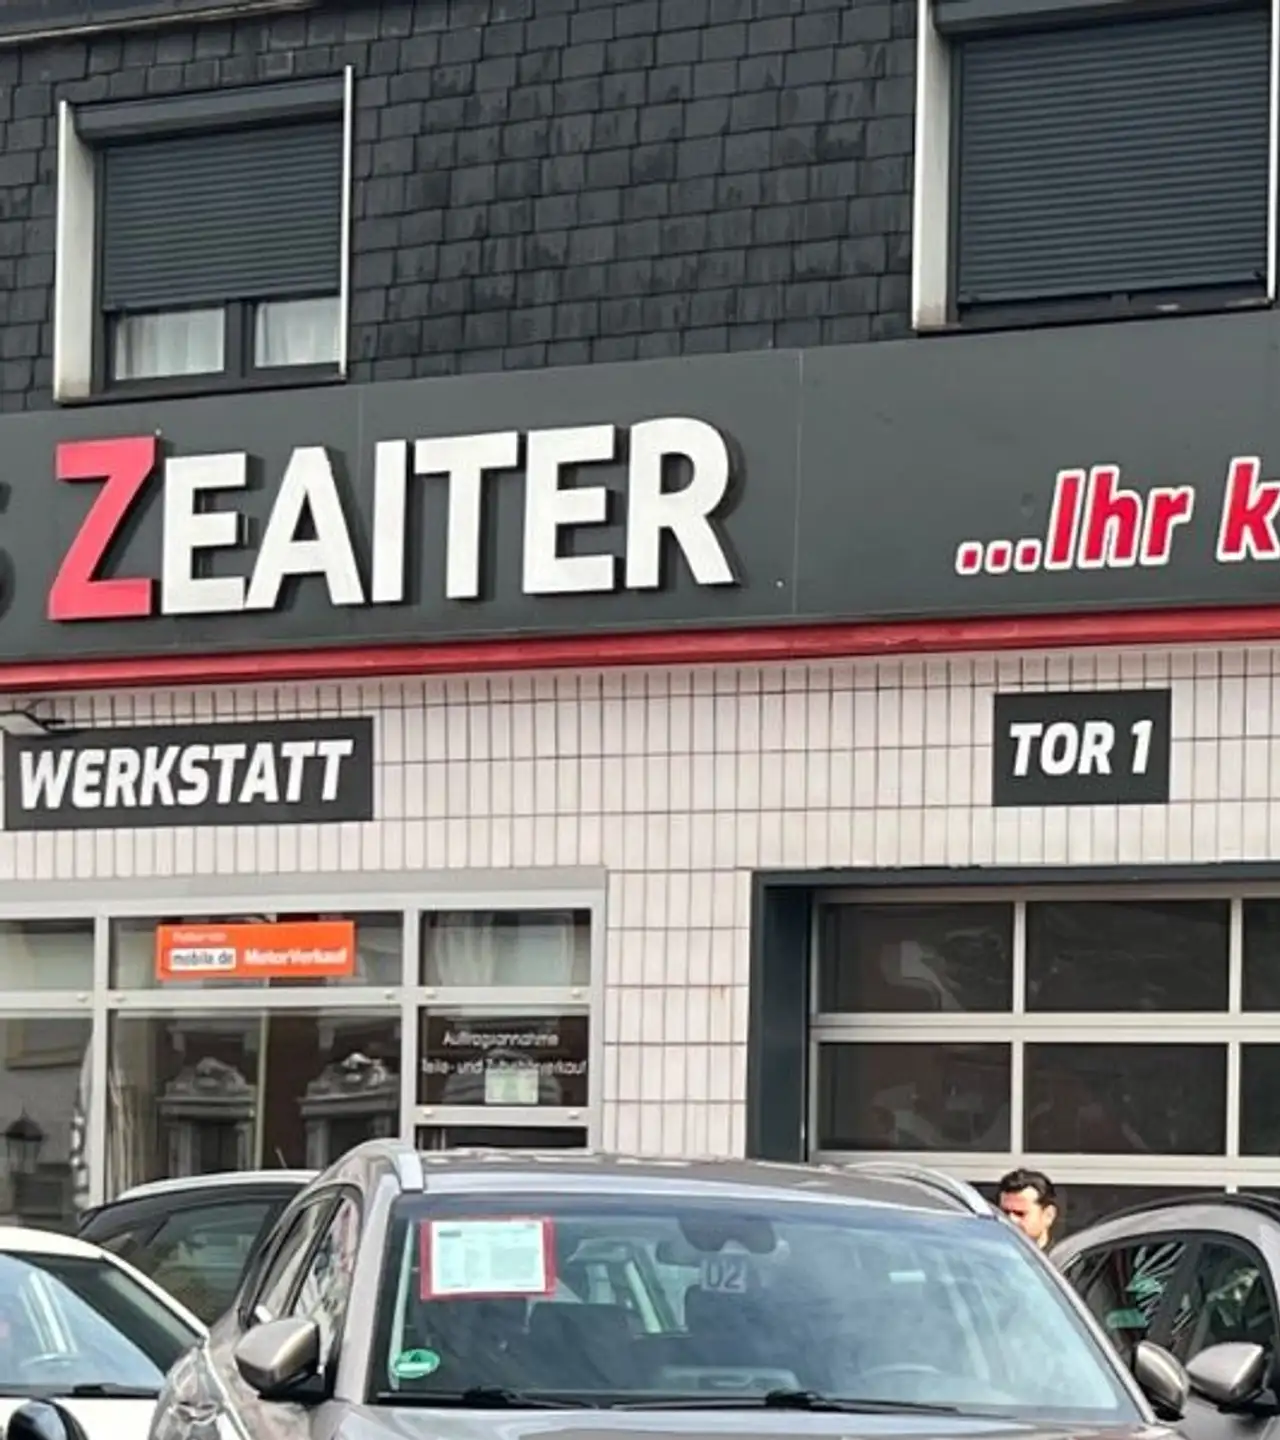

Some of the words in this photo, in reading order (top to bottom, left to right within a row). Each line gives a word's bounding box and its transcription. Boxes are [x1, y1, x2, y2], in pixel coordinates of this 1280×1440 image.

[46, 417, 738, 621] ZEAITER
[956, 465, 1193, 575] ...Ihr
[20, 739, 352, 809] WERKSTATT
[1009, 721, 1114, 777] TOR
[1131, 720, 1152, 774] 1
